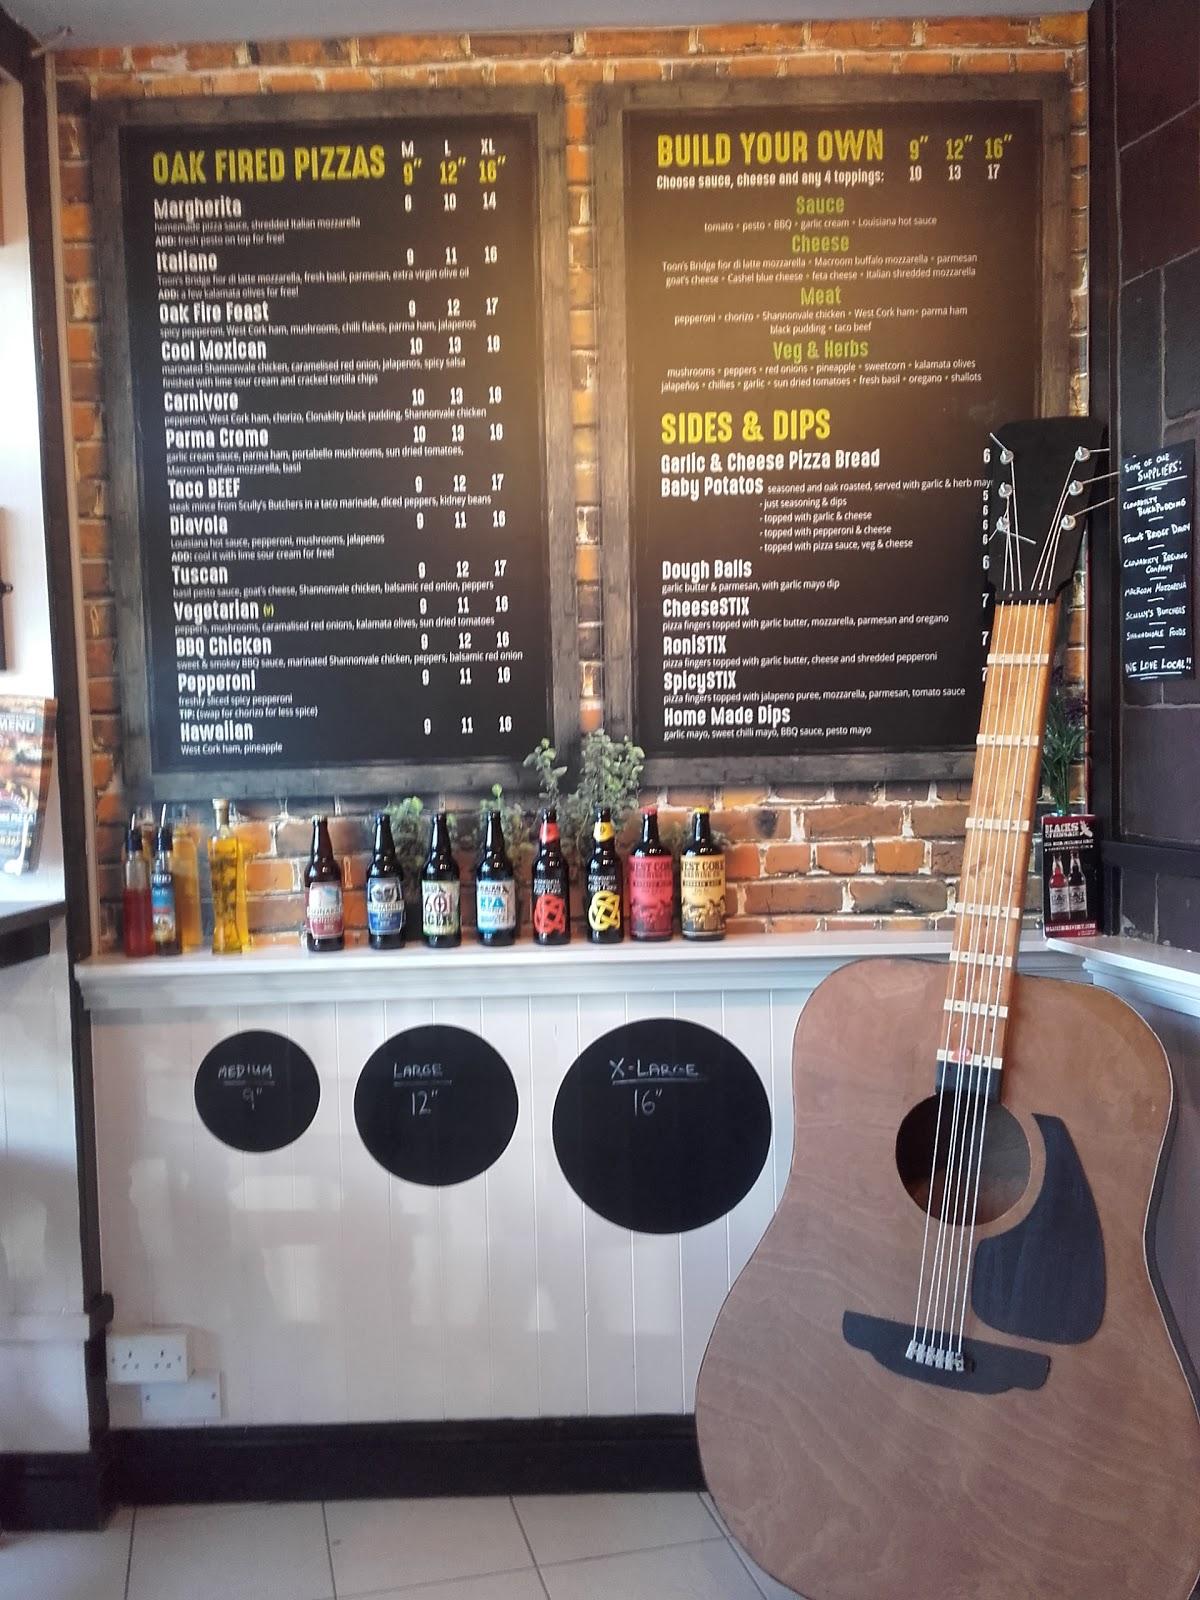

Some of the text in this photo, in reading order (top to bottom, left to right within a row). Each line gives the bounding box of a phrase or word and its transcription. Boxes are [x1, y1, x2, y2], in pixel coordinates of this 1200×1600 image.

[402, 141, 414, 158] M
[445, 139, 451, 156] L
[481, 138, 495, 155] XL
[658, 128, 883, 168] BUILD YOUR OWN
[152, 145, 385, 185] OAK FIRED PIZZAS
[909, 164, 1000, 182] 10 13 17
[657, 168, 884, 190] Choose sauce, cheese and any 4 toppings:
[154, 195, 242, 222] Margherita
[444, 193, 456, 211] 10
[483, 192, 497, 210] 14
[796, 196, 845, 215] Sauce
[792, 234, 849, 253] Cheese
[157, 250, 217, 273] Italiano
[800, 286, 841, 306] Meat
[159, 300, 269, 324] Oak Fire Feast
[447, 298, 460, 317] 12
[486, 297, 499, 316] 17
[162, 338, 267, 361] Cool Mexican
[773, 339, 868, 364] Veg & Herbs
[164, 389, 238, 412] Carnivore
[661, 408, 831, 444] SIDES & DIPS
[166, 428, 215, 449] Parma
[661, 448, 991, 474] Garlic & Cheese Pizza Bread 6
[168, 478, 241, 499] Taco BEEF
[661, 476, 764, 501] Baby Potatos
[768, 481, 805, 492] seasoned
[806, 481, 822, 491] and
[824, 480, 839, 491] oak
[840, 479, 873, 491] roasted,
[874, 478, 901, 489] served
[902, 477, 920, 488] with
[921, 477, 943, 490] garlic
[953, 476, 972, 487] herb
[764, 496, 779, 509] just
[780, 495, 820, 509] seasoning
[830, 494, 847, 507] dips
[982, 490, 989, 501] 5
[982, 505, 989, 516] 6
[170, 515, 228, 535] Diavola
[982, 519, 988, 530] 6
[764, 540, 793, 553] topped
[794, 539, 811, 550] with
[813, 539, 833, 552] pizza
[835, 541, 860, 550] sauce,
[861, 540, 876, 551] veg
[885, 536, 914, 547] cheese
[456, 560, 469, 578] 12
[494, 559, 507, 576] 17
[662, 559, 752, 582] Dough Balls
[982, 555, 990, 570] 6
[172, 565, 228, 585] Tuscan
[661, 581, 683, 594] garlic
[684, 580, 709, 591] butter
[718, 582, 760, 593] parmesan,
[761, 579, 779, 589] with
[780, 578, 802, 591] garlic
[803, 580, 825, 591] mayo
[827, 577, 840, 590] dip
[173, 598, 259, 624] Vegetarian
[663, 593, 989, 618] CheeseSTIX 7
[176, 634, 272, 658] BBQ Chicken
[663, 631, 989, 656] RoniSTIX 7
[1125, 661, 1137, 673] WE
[1140, 659, 1158, 671] LOVE
[178, 670, 256, 696] Pepperoni
[664, 667, 988, 694] SpicySTIX 7
[664, 704, 790, 727] Home Made Dips
[180, 720, 253, 742] Hawaiian
[218, 1064, 272, 1079] MEDIUM
[393, 1062, 442, 1079] LARGE
[609, 1057, 699, 1079] X-LARGE
